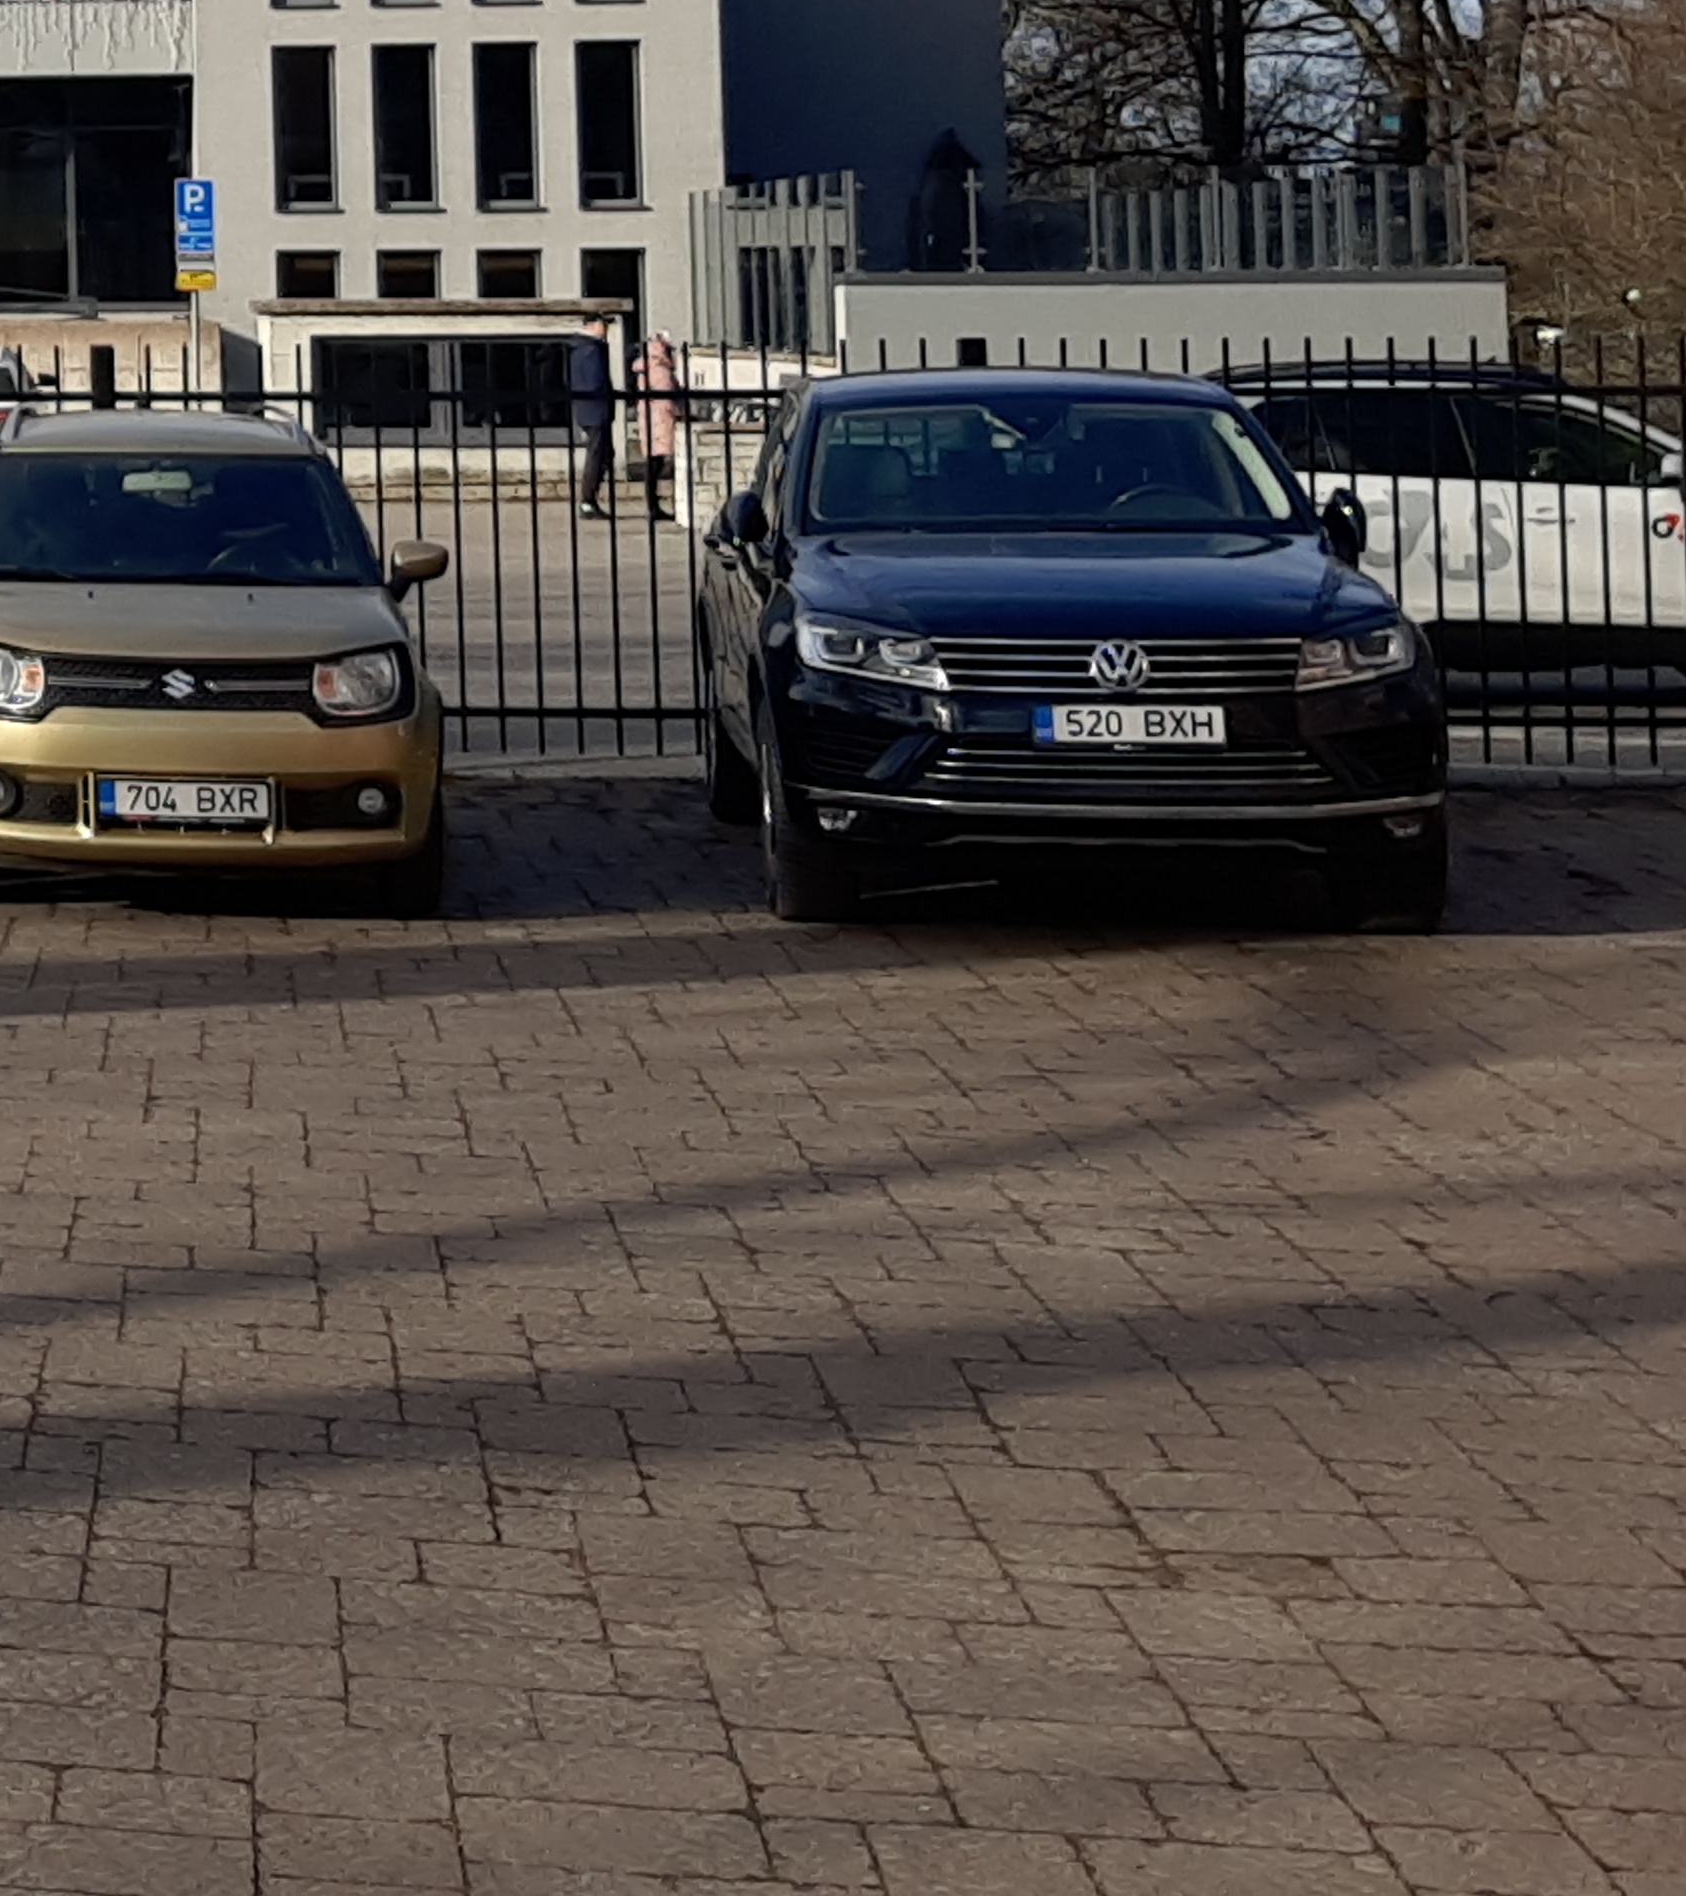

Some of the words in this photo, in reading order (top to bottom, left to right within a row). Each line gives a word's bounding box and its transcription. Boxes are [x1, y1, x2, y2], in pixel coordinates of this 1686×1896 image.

[1065, 709, 1123, 737] 520
[1144, 710, 1214, 738] BXH
[127, 784, 177, 812] 704
[197, 787, 258, 813] BXR
